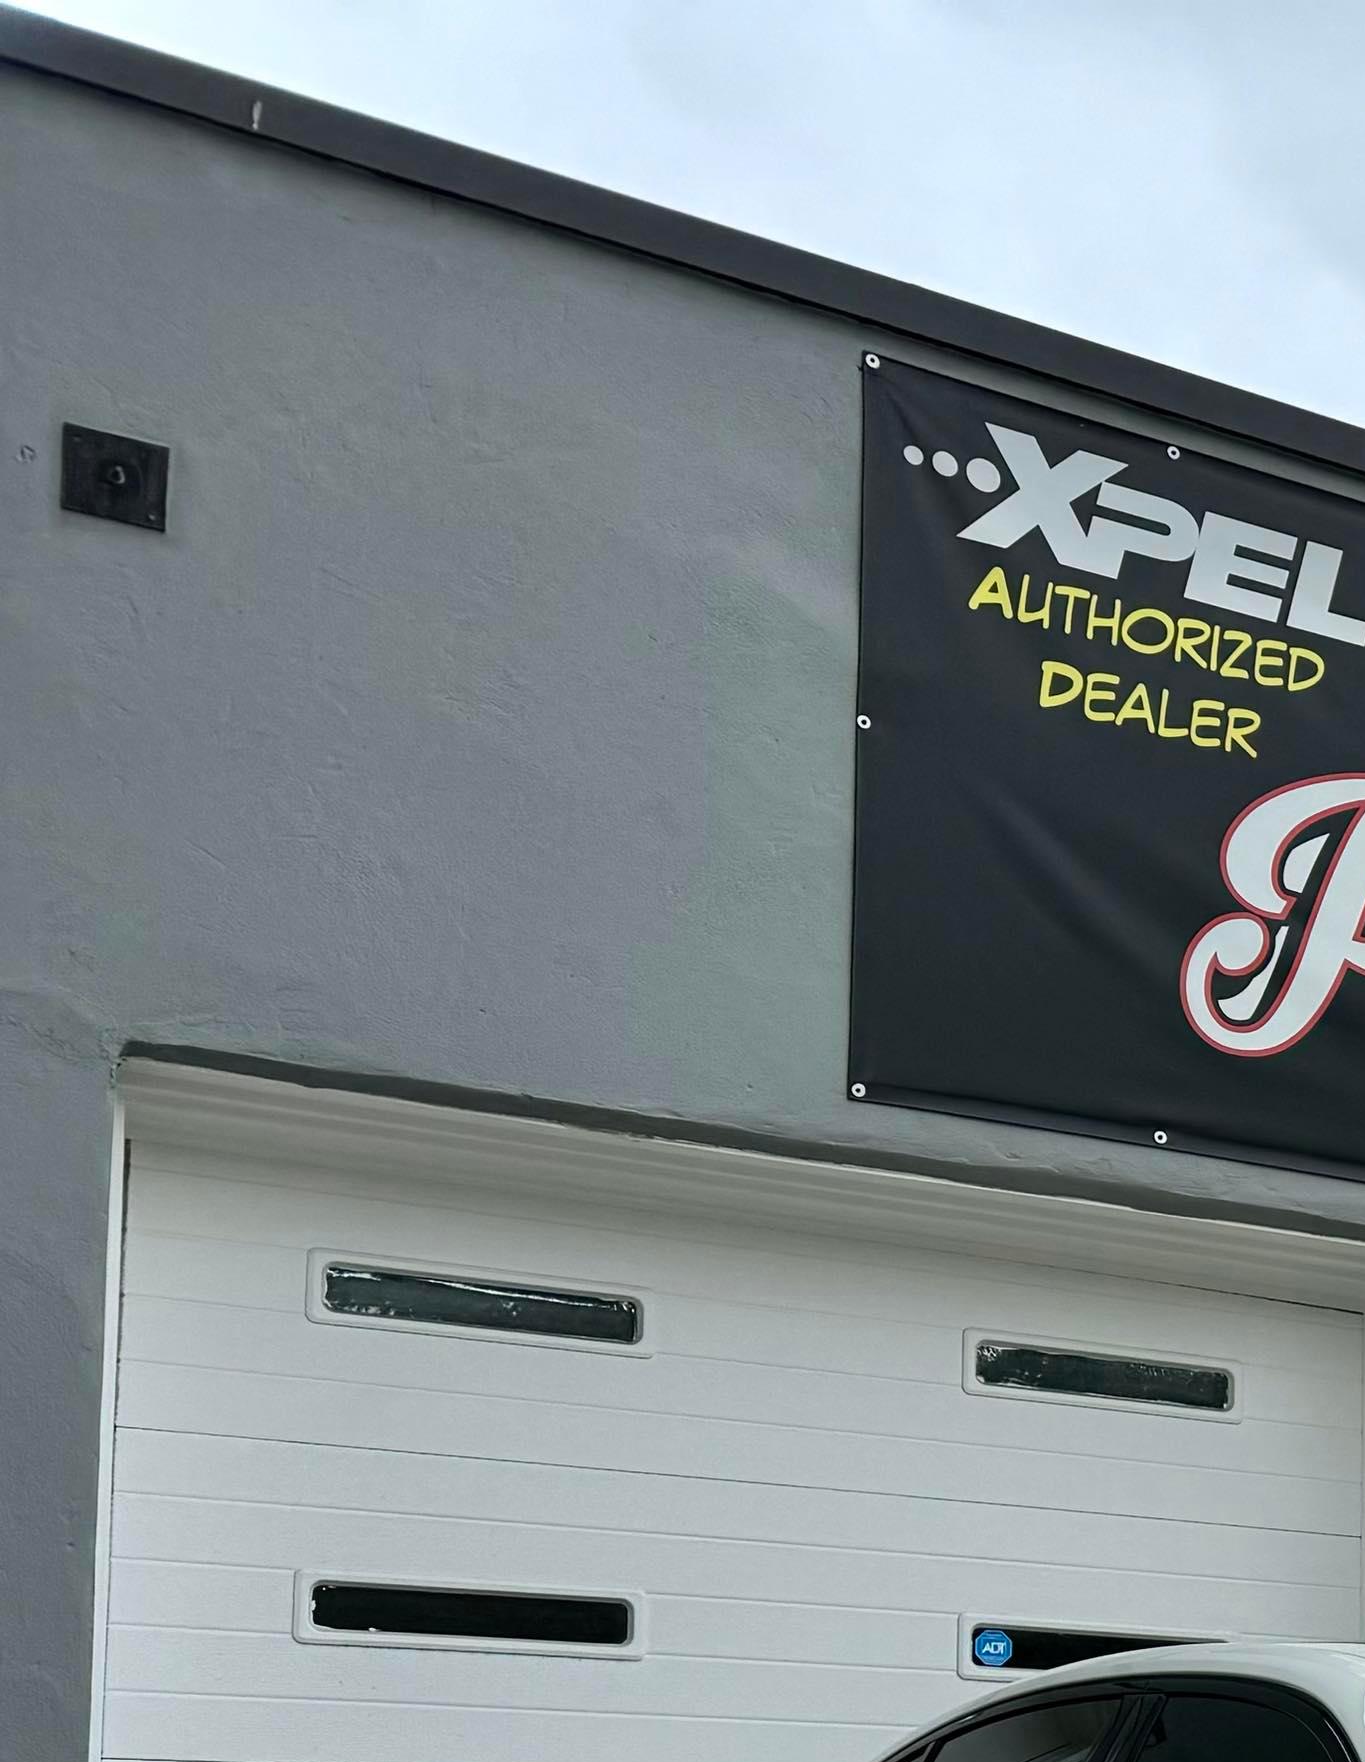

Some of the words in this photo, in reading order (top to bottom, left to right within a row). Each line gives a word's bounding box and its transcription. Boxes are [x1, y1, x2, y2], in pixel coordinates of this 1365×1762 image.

[968, 566, 1325, 692] AUTHORIZED
[1039, 660, 1262, 758] DEALER
[982, 1641, 1006, 1655] ADT
